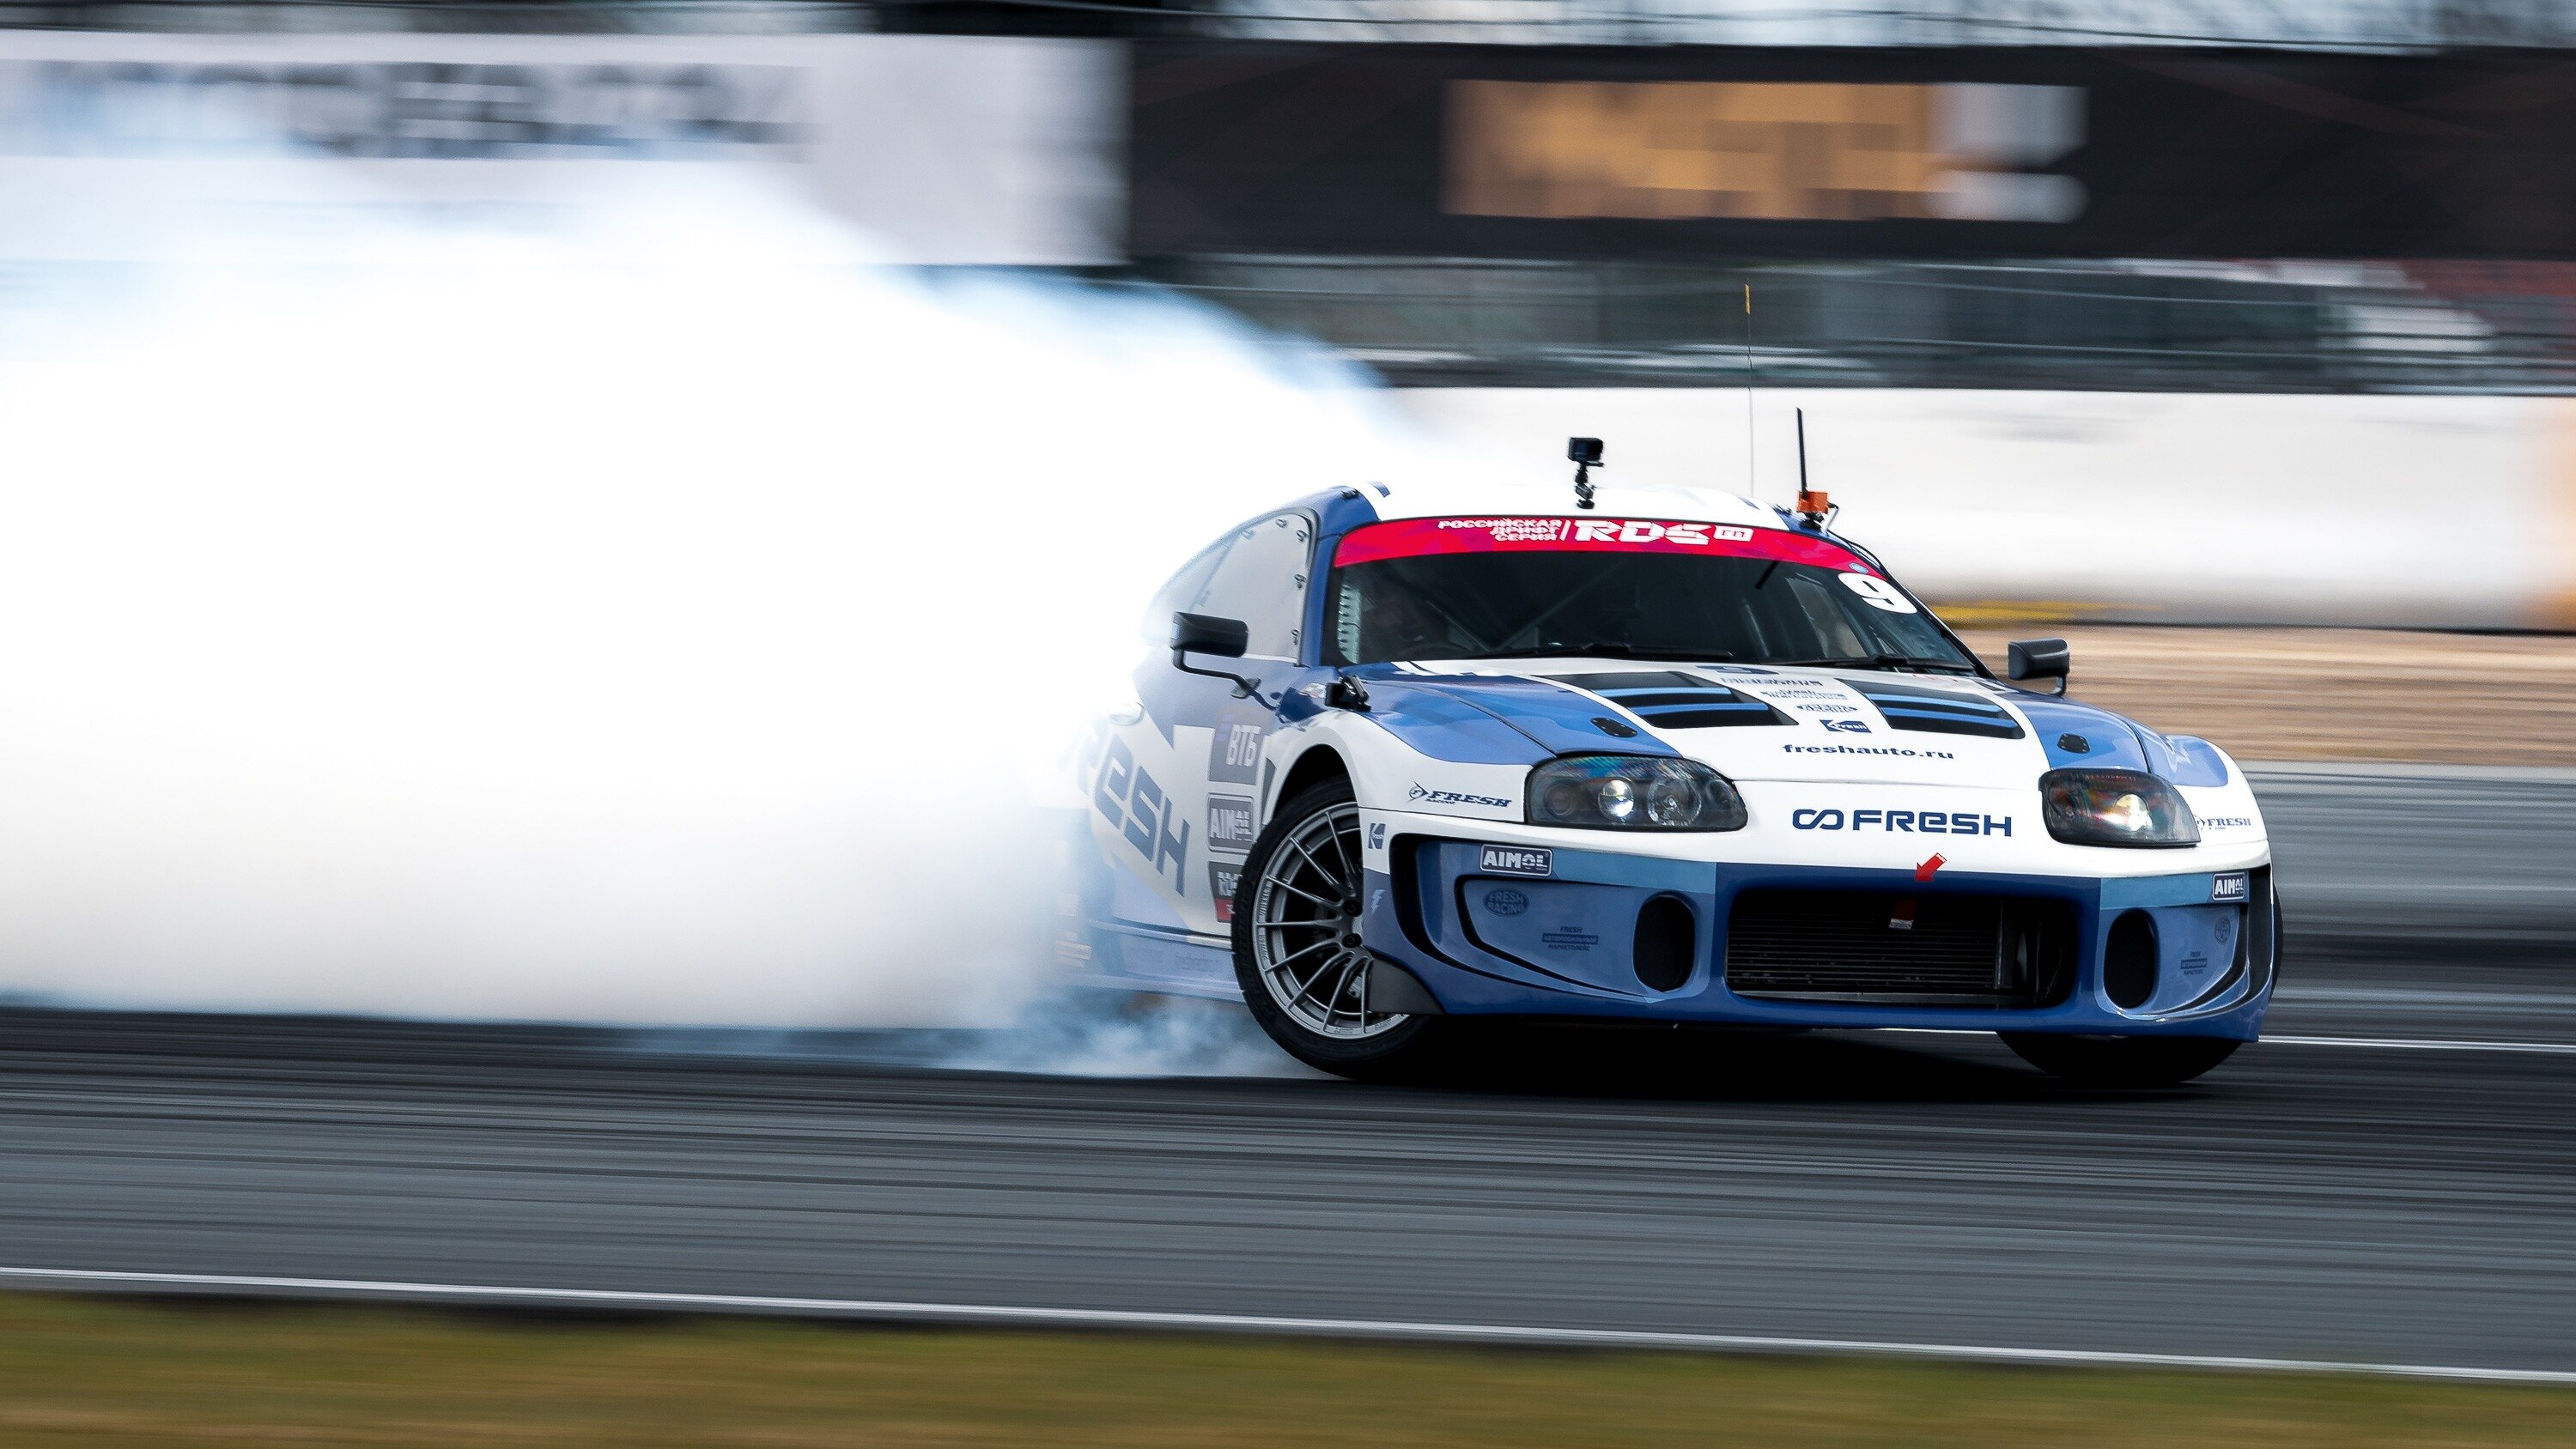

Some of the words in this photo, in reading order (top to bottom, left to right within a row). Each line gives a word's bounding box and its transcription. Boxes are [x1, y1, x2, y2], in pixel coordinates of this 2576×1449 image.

[1574, 520, 1712, 545] RDS
[1838, 573, 1918, 614] 9
[1225, 724, 1261, 767] ВТБ
[1783, 744, 1954, 759] freshauto.ru
[1427, 791, 1512, 807] FRESH
[1852, 809, 2012, 837] FRESH
[1483, 851, 1548, 870] AIMOL
[1489, 890, 1524, 904] FRESH
[1487, 901, 1524, 914] RACING
